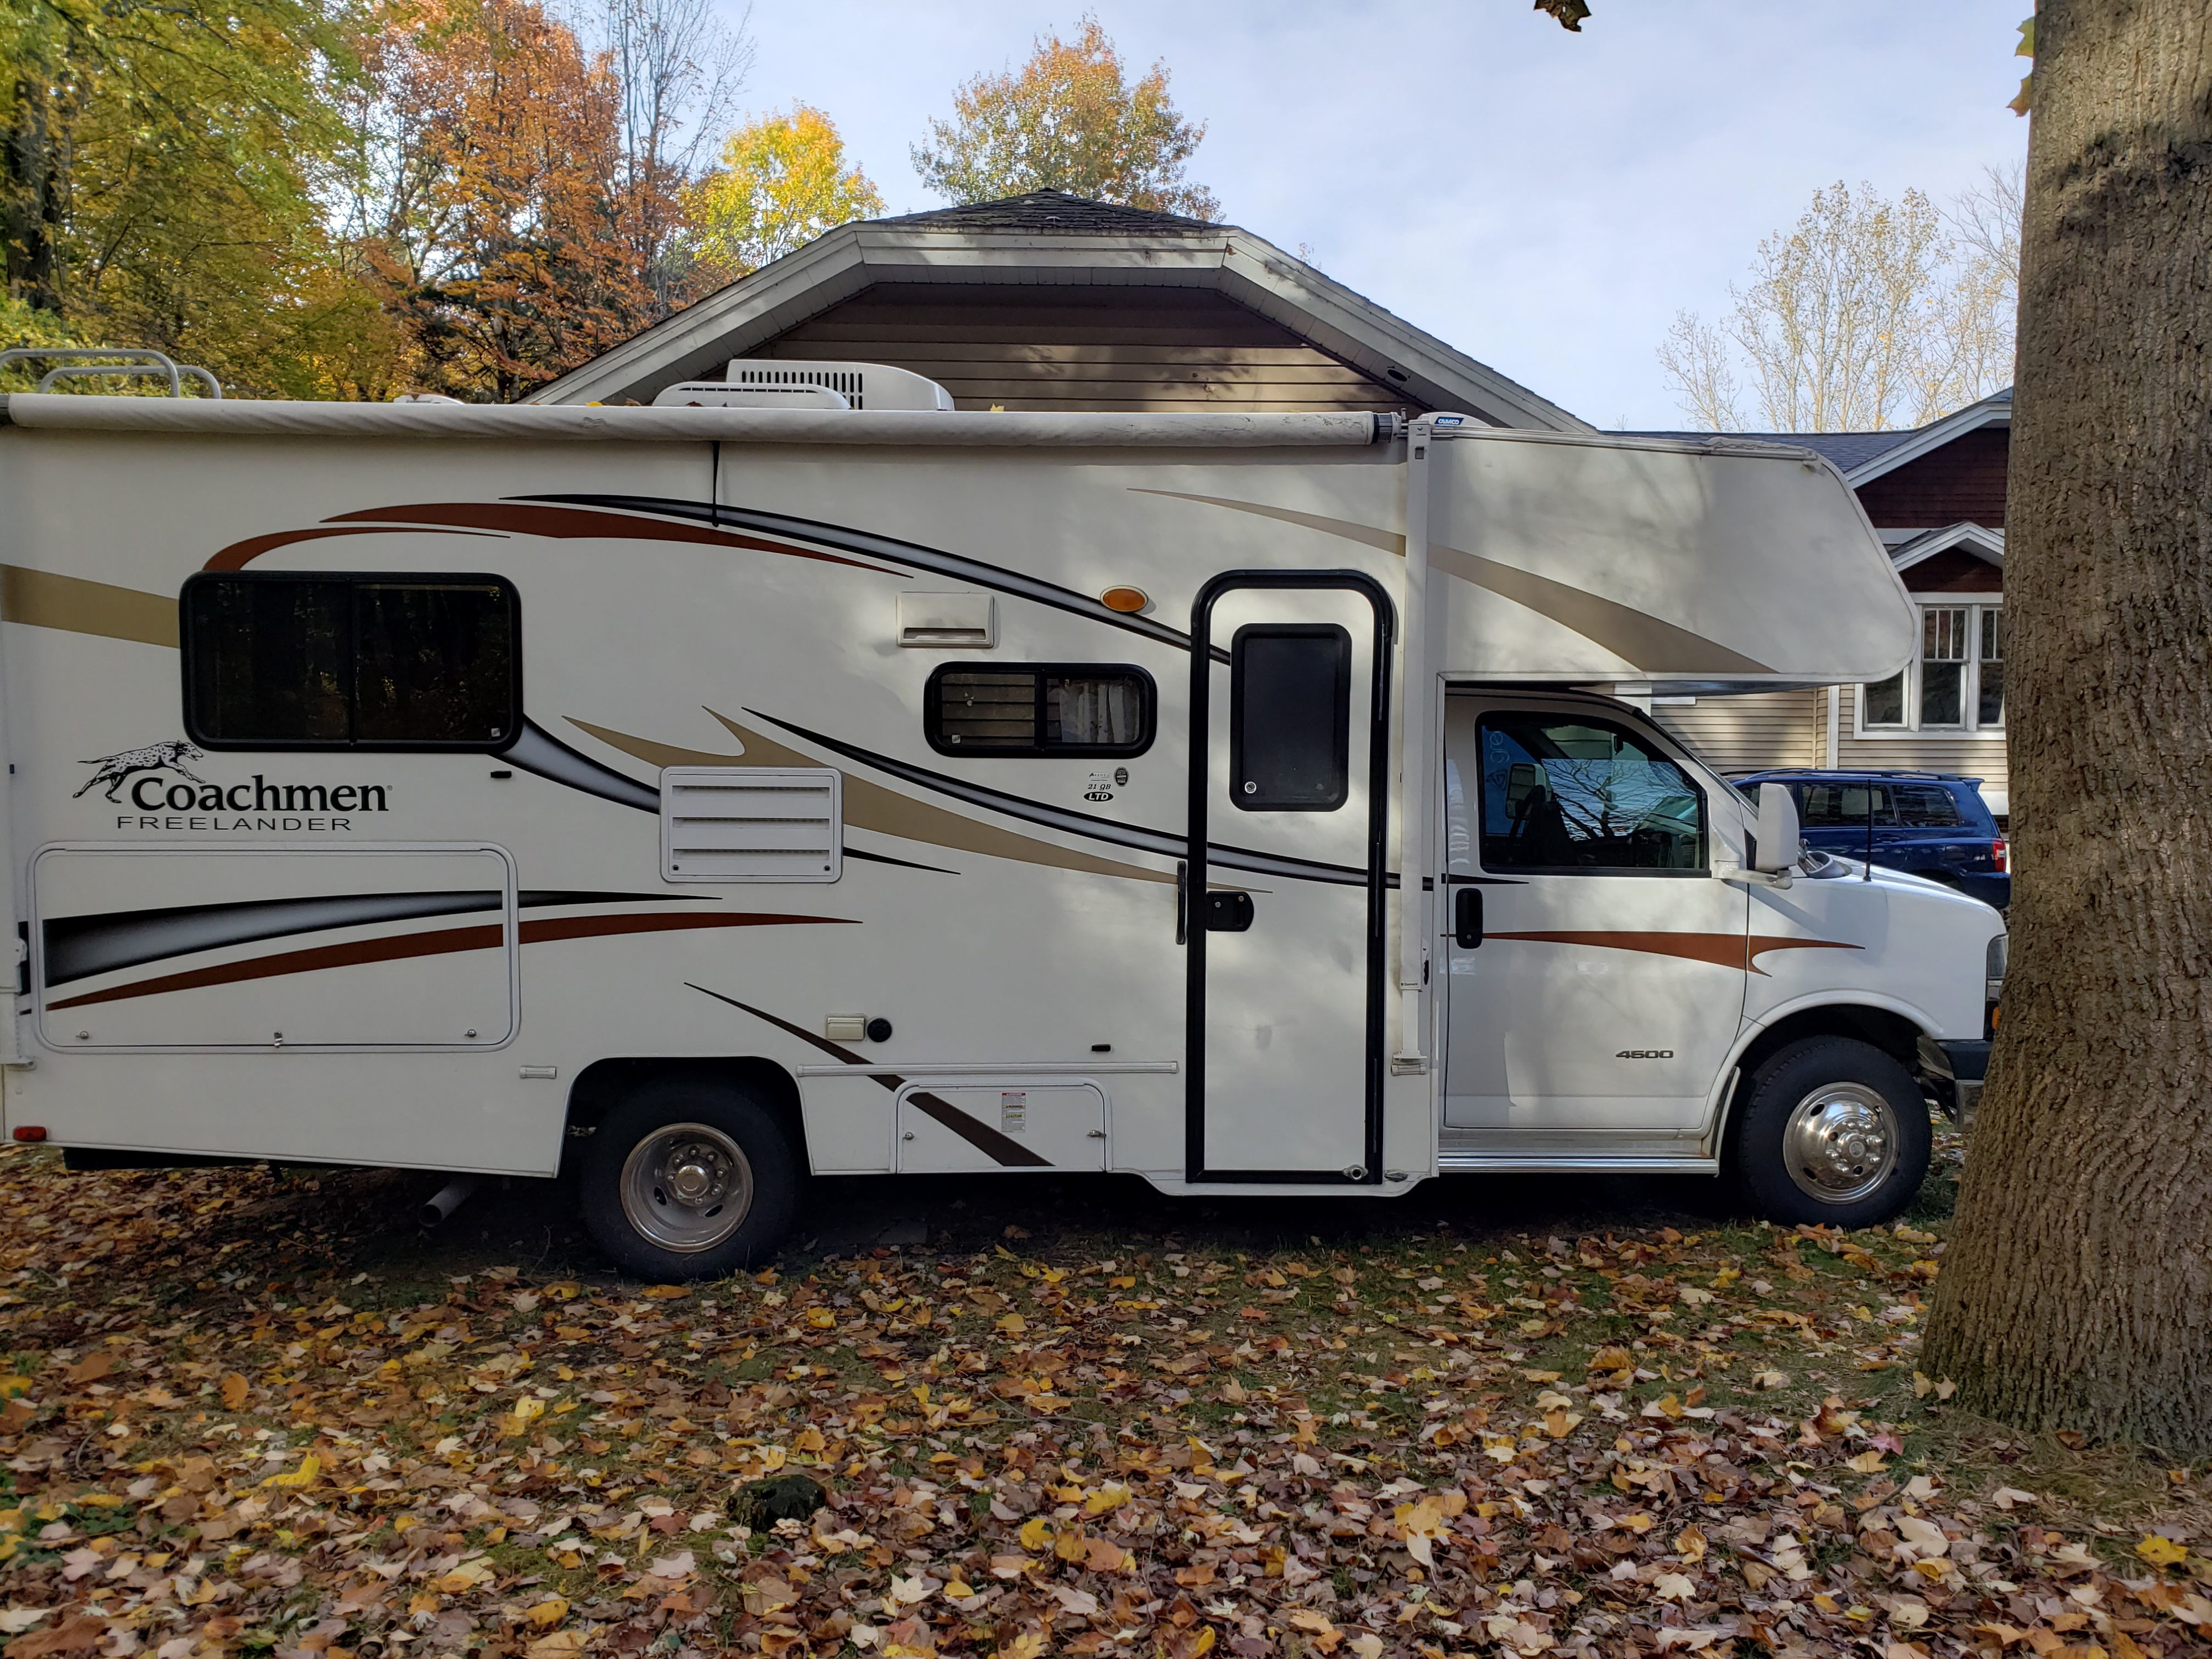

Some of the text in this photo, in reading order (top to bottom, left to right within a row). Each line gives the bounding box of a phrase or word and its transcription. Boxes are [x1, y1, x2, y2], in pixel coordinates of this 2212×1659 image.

[131, 774, 389, 812] Coachmen
[117, 816, 352, 831] FREELANDER
[1615, 1050, 1674, 1059] 4500
